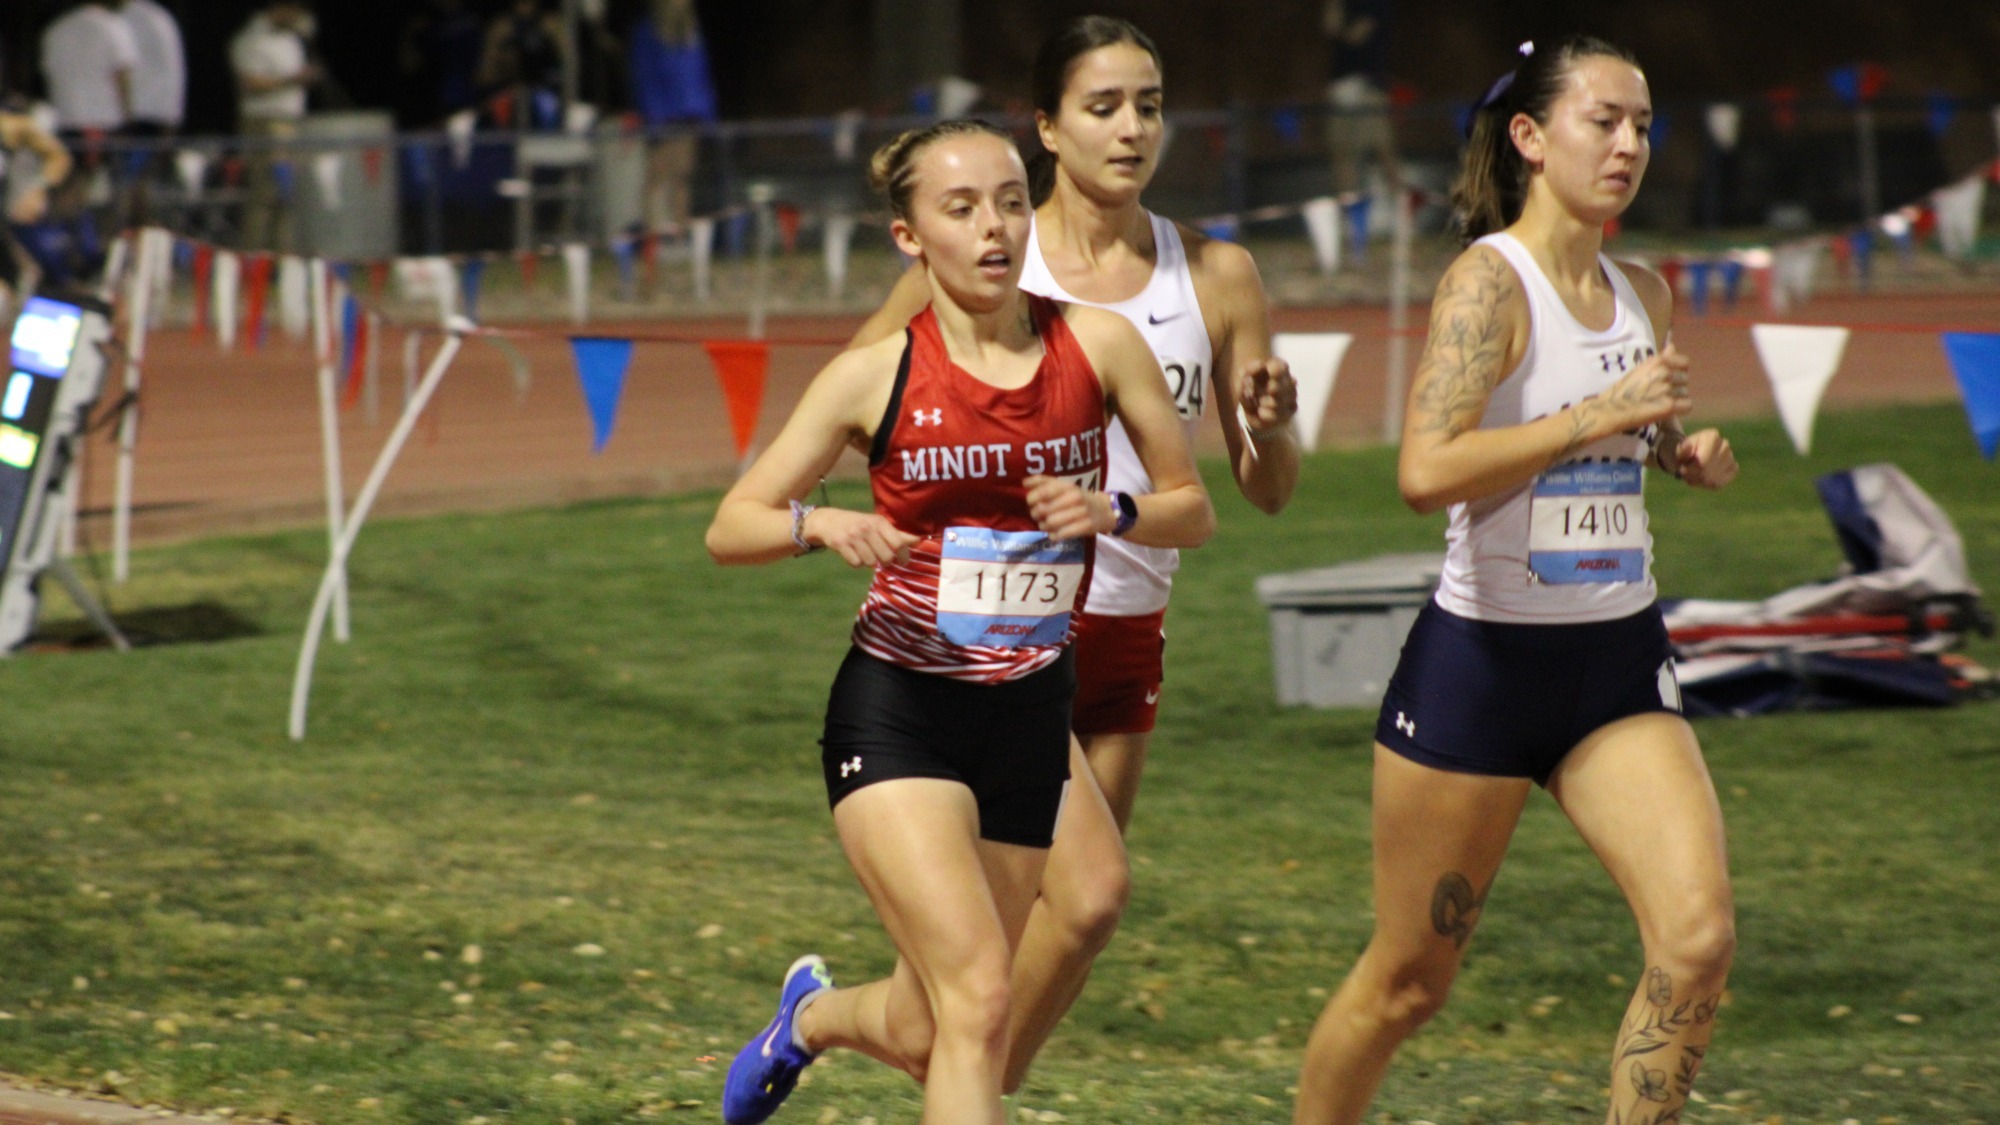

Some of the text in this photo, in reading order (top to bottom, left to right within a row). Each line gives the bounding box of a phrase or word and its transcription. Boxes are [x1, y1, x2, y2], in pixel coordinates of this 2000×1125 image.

[901, 426, 1101, 481] MINOT STATE
[1563, 503, 1628, 536] 1410
[975, 569, 1059, 603] 1173
[983, 623, 1038, 636] ARIZONA
